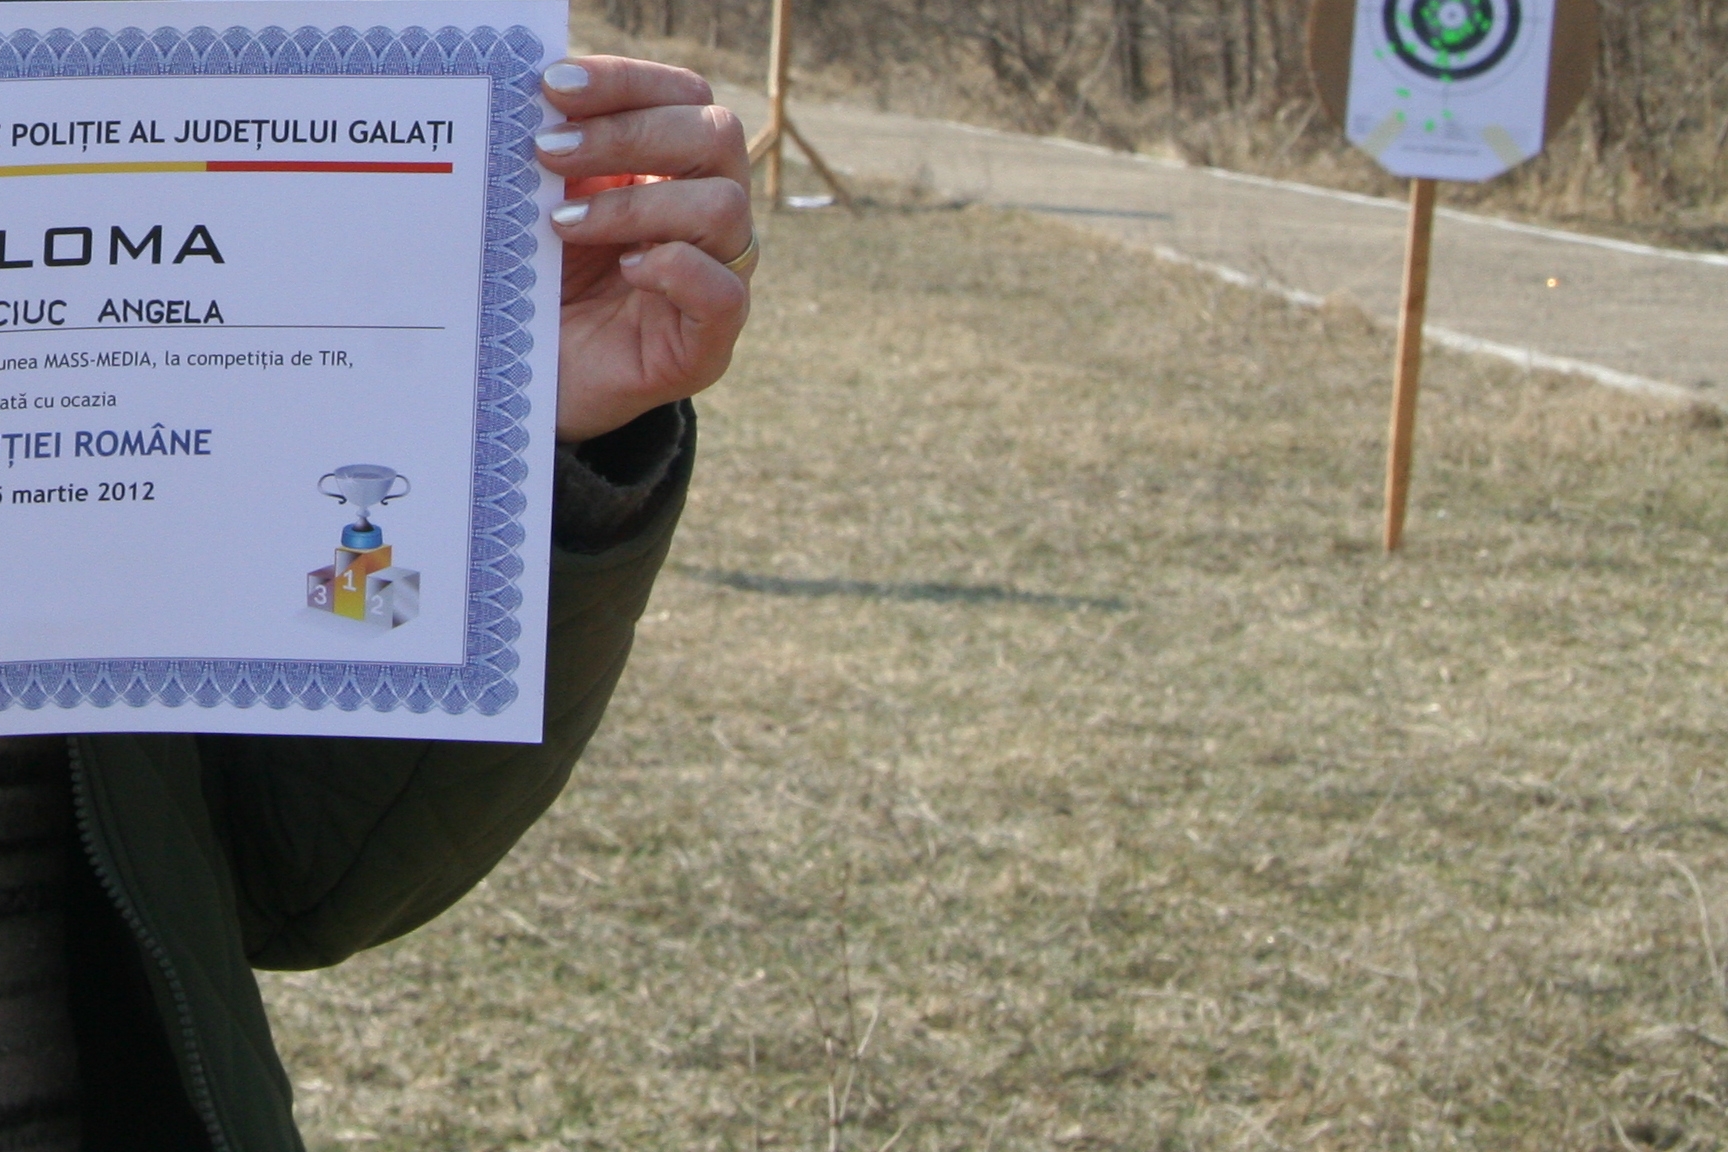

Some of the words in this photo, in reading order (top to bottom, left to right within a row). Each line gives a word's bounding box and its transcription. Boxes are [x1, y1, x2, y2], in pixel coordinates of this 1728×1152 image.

[11, 120, 122, 153] POLIȚIE
[128, 119, 166, 144] AL
[173, 119, 338, 151] JUDEȚULUI
[348, 119, 453, 152] GALAȚI
[97, 298, 225, 325] ANGELA
[43, 350, 157, 369] MASS-MEDIA,
[165, 350, 181, 366] la
[186, 351, 284, 370] competiția
[290, 350, 313, 366] de
[318, 350, 353, 369] TIR,
[33, 396, 55, 409] cu
[60, 394, 117, 408] ocazia
[74, 421, 213, 458] ROMÂNE
[12, 483, 89, 504] martie
[97, 481, 155, 502] 2012
[343, 570, 357, 591] 1
[314, 585, 327, 605] 3
[371, 595, 384, 615] 2
